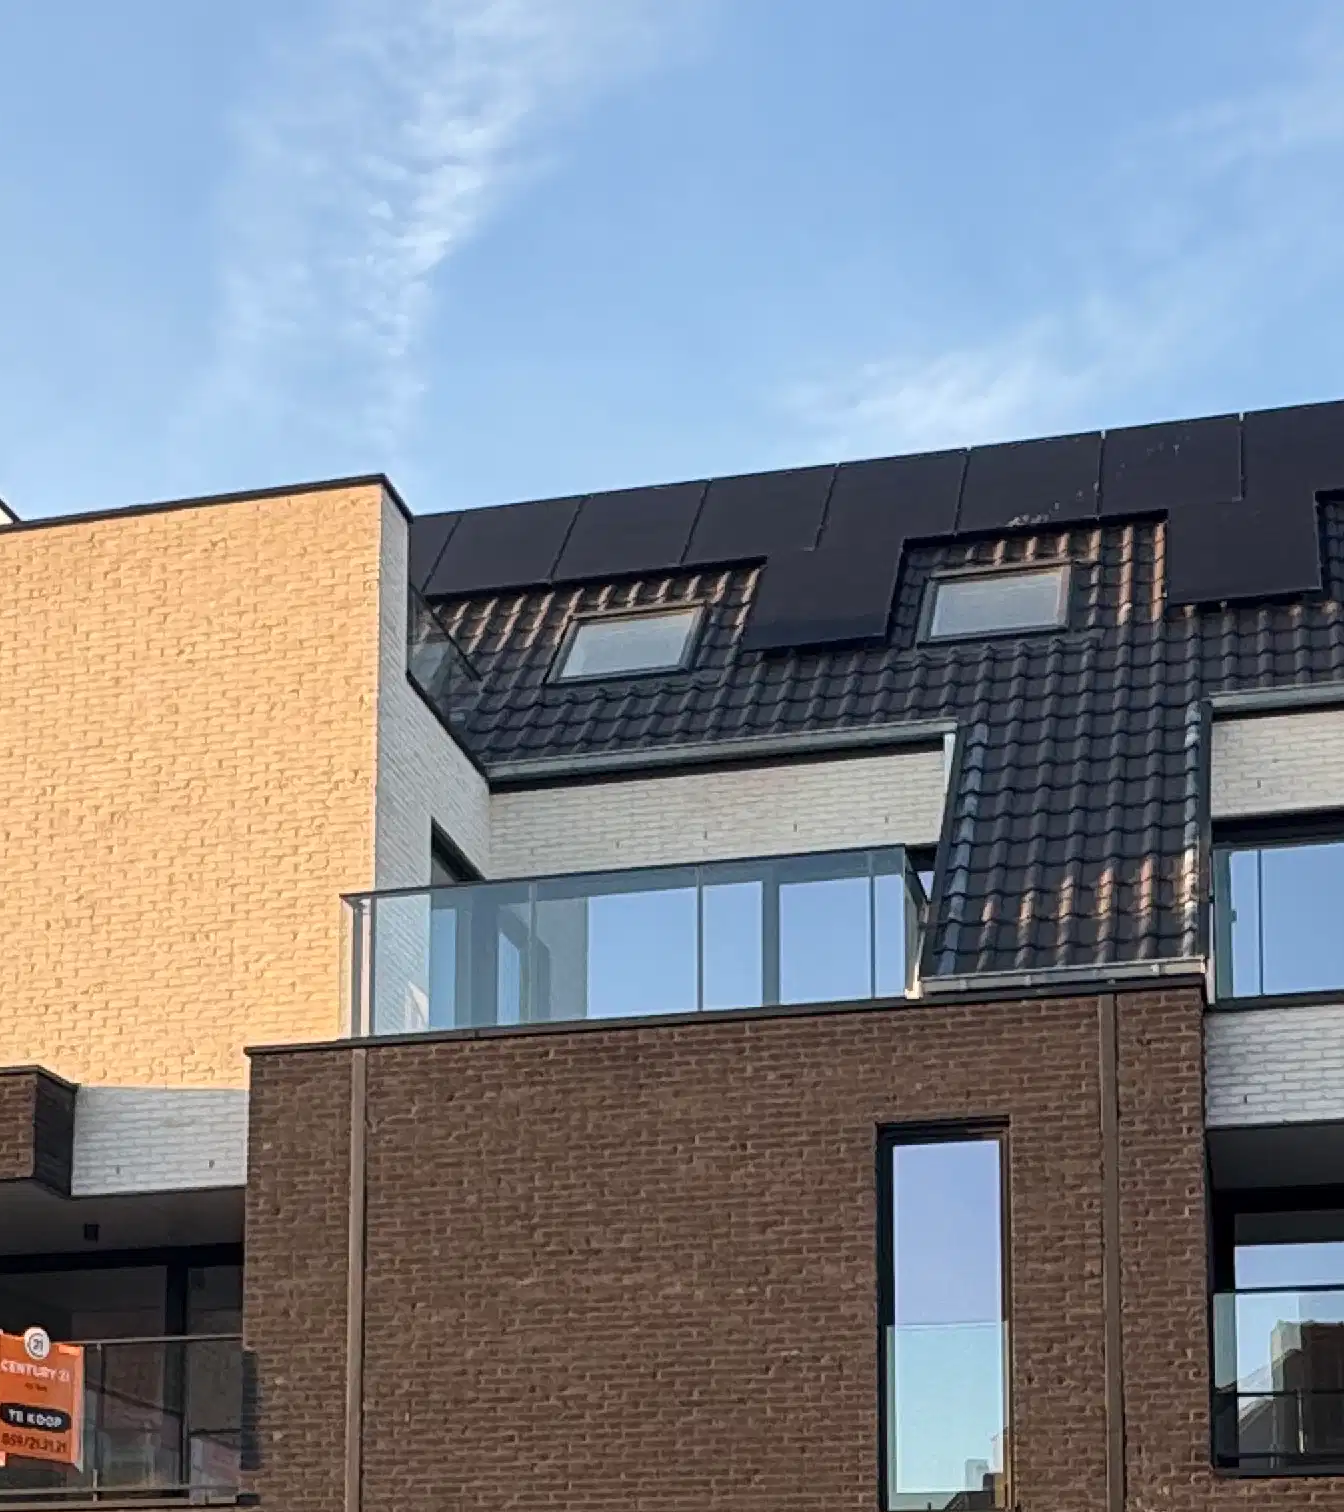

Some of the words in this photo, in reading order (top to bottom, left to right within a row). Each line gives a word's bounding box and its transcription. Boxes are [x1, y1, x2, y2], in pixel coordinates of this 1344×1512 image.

[1, 1360, 55, 1379] CENTURY
[8, 1408, 24, 1423] TE
[26, 1412, 62, 1428] KOOP
